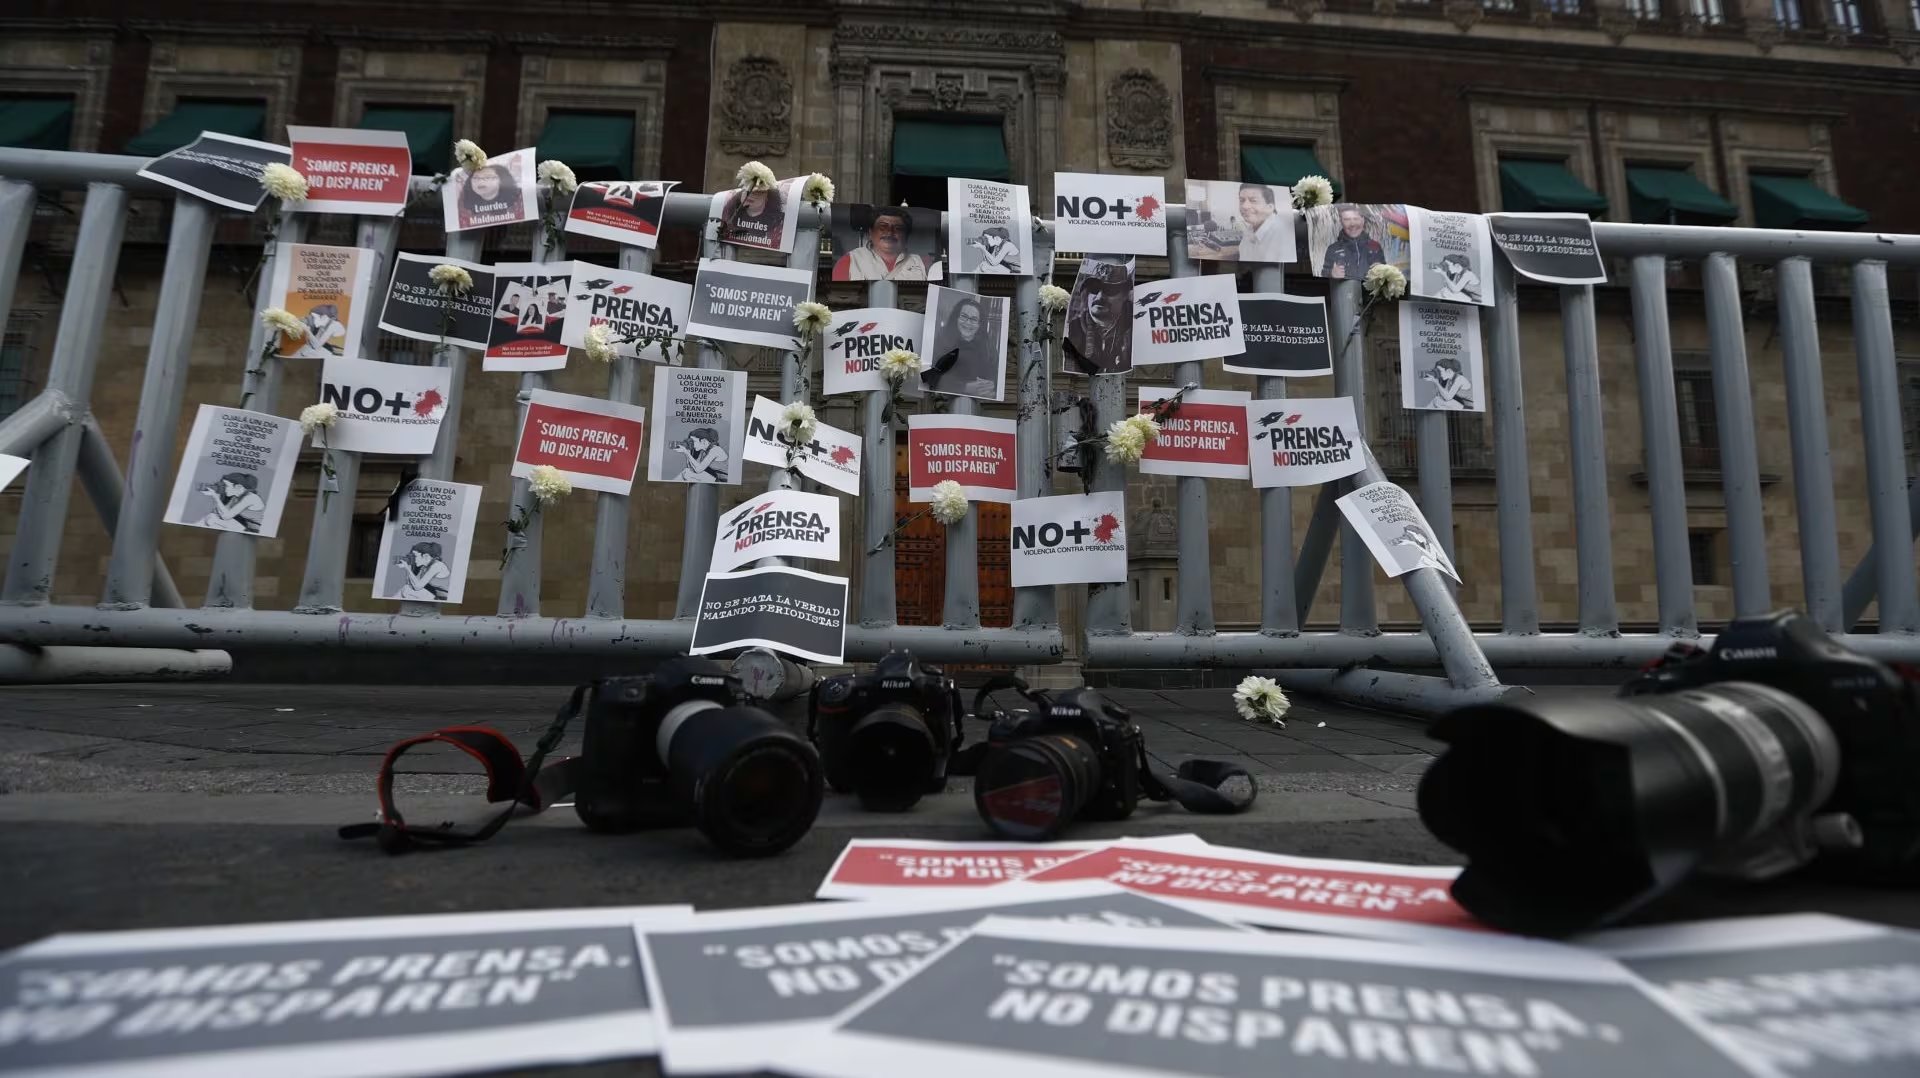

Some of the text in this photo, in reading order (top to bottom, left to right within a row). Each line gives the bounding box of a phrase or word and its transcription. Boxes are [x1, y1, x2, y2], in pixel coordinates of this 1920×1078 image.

[308, 175, 323, 188] NO
[474, 202, 508, 212] Lourdes
[1056, 196, 1132, 220] NO+
[470, 212, 515, 226] Maldonado
[737, 218, 768, 231] Lourdes
[1522, 235, 1544, 243] MATA
[1546, 235, 1557, 243] LA
[1560, 236, 1592, 246] VERDAD
[1536, 245, 1595, 256] PERIODISTAS
[395, 282, 410, 292] NO
[411, 286, 426, 294] SE
[706, 284, 748, 302] "SOMOS
[392, 291, 439, 307] MATANDO
[592, 294, 678, 333] PRENSA,
[710, 302, 787, 321] NO DISPAREN"
[1149, 302, 1234, 328] PRENSA,
[1288, 326, 1323, 334] VERDAD
[1264, 334, 1325, 344] PERIODISTAS
[322, 383, 411, 416] NO+
[371, 416, 400, 424] CONTRA
[226, 428, 266, 439] DISPAROS
[537, 418, 580, 441] "SOMOS
[1157, 434, 1230, 450] NO DISPAREN"
[1270, 426, 1353, 450] PRENSA,
[214, 439, 271, 453] ESCUCHEMOS
[540, 440, 618, 463] NO DISPAREN"
[919, 442, 1006, 461] "SOMOS PRENSA,
[223, 453, 266, 465] NUESTRAS
[821, 459, 858, 476] PERIODISTAS
[928, 460, 1000, 474] NO DISPAREN"
[736, 510, 830, 539] PRENSA,
[1012, 520, 1090, 550] NO+
[1024, 547, 1056, 556] VIOLENCIA
[1057, 546, 1084, 554] CONTRA
[705, 594, 840, 616] NO SE MATA LA VERDAD
[703, 604, 840, 628] MATANDO PERIODISTAS
[1720, 646, 1777, 660] Canon
[691, 675, 724, 685] Canon
[882, 680, 910, 688] Nikon
[1051, 707, 1081, 716] Nikon
[902, 868, 954, 878] NO
[1106, 870, 1168, 885] NO
[768, 964, 861, 998] NO
[988, 988, 1093, 1026] NO
